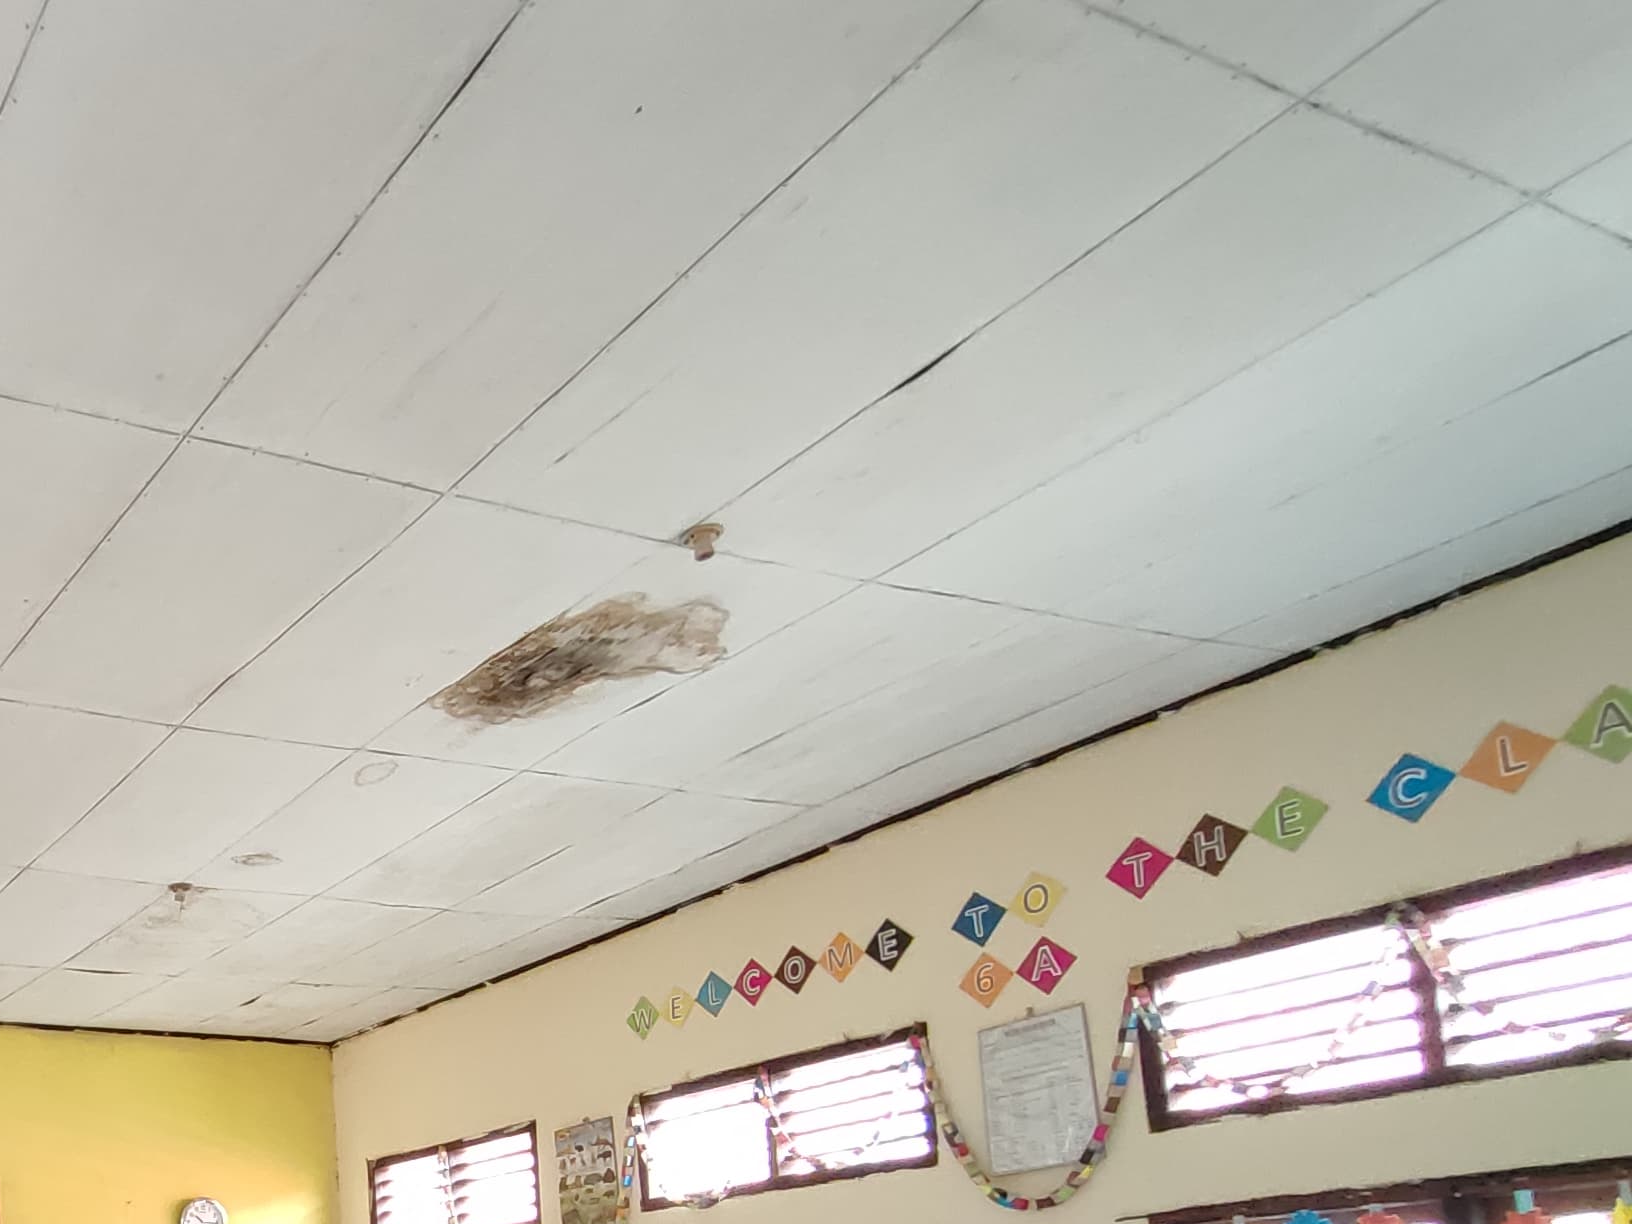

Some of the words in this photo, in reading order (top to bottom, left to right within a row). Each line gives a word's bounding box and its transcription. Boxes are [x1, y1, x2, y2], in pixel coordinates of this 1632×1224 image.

[632, 928, 898, 1034] WELCOME
[965, 883, 1049, 938] TO
[1122, 799, 1304, 889] THE
[976, 944, 1062, 995] 6A
